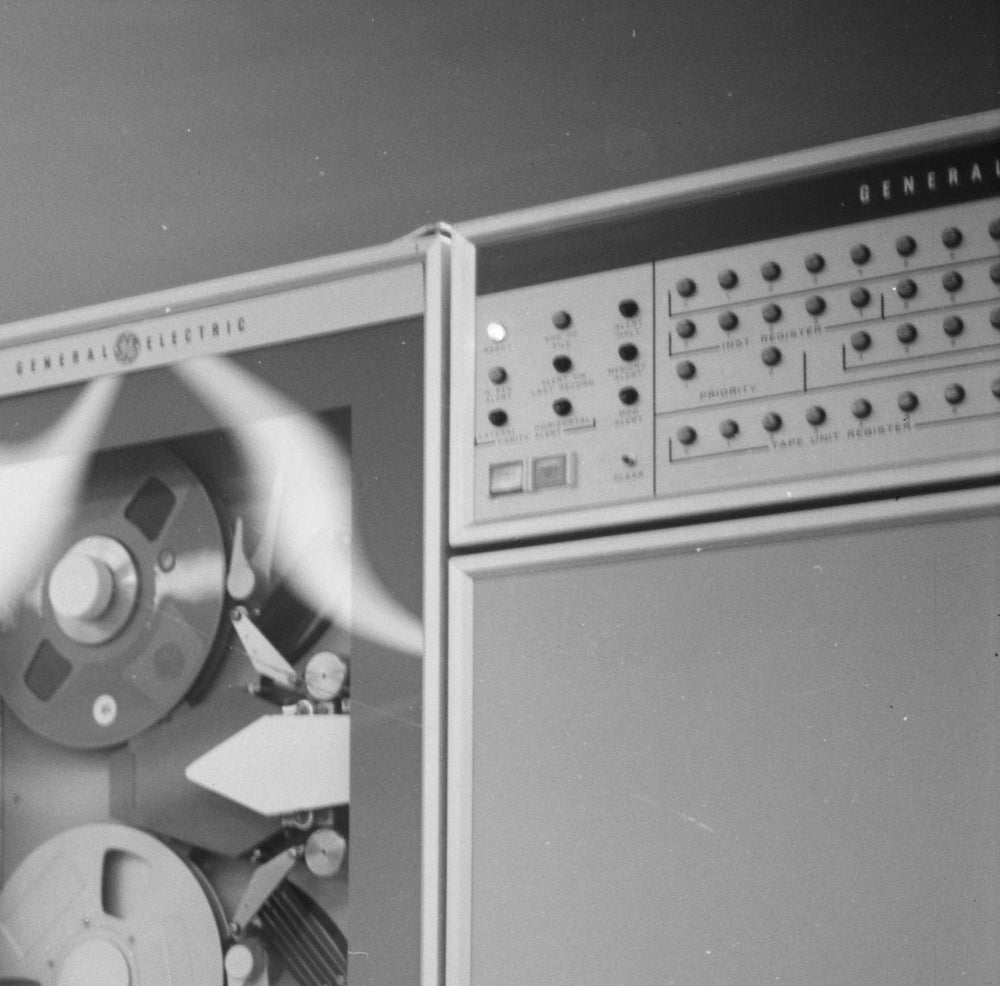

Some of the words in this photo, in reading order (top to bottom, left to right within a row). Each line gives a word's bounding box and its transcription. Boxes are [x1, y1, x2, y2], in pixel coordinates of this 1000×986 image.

[17, 345, 107, 375] GENERAL
[147, 316, 246, 350] ELECTRIC
[722, 337, 750, 351] INST
[760, 324, 823, 344] REGISTER
[699, 383, 758, 401] PRIORITY
[770, 435, 805, 452] TAPE
[810, 430, 842, 446] UNIT
[846, 421, 912, 440] REGISTER
